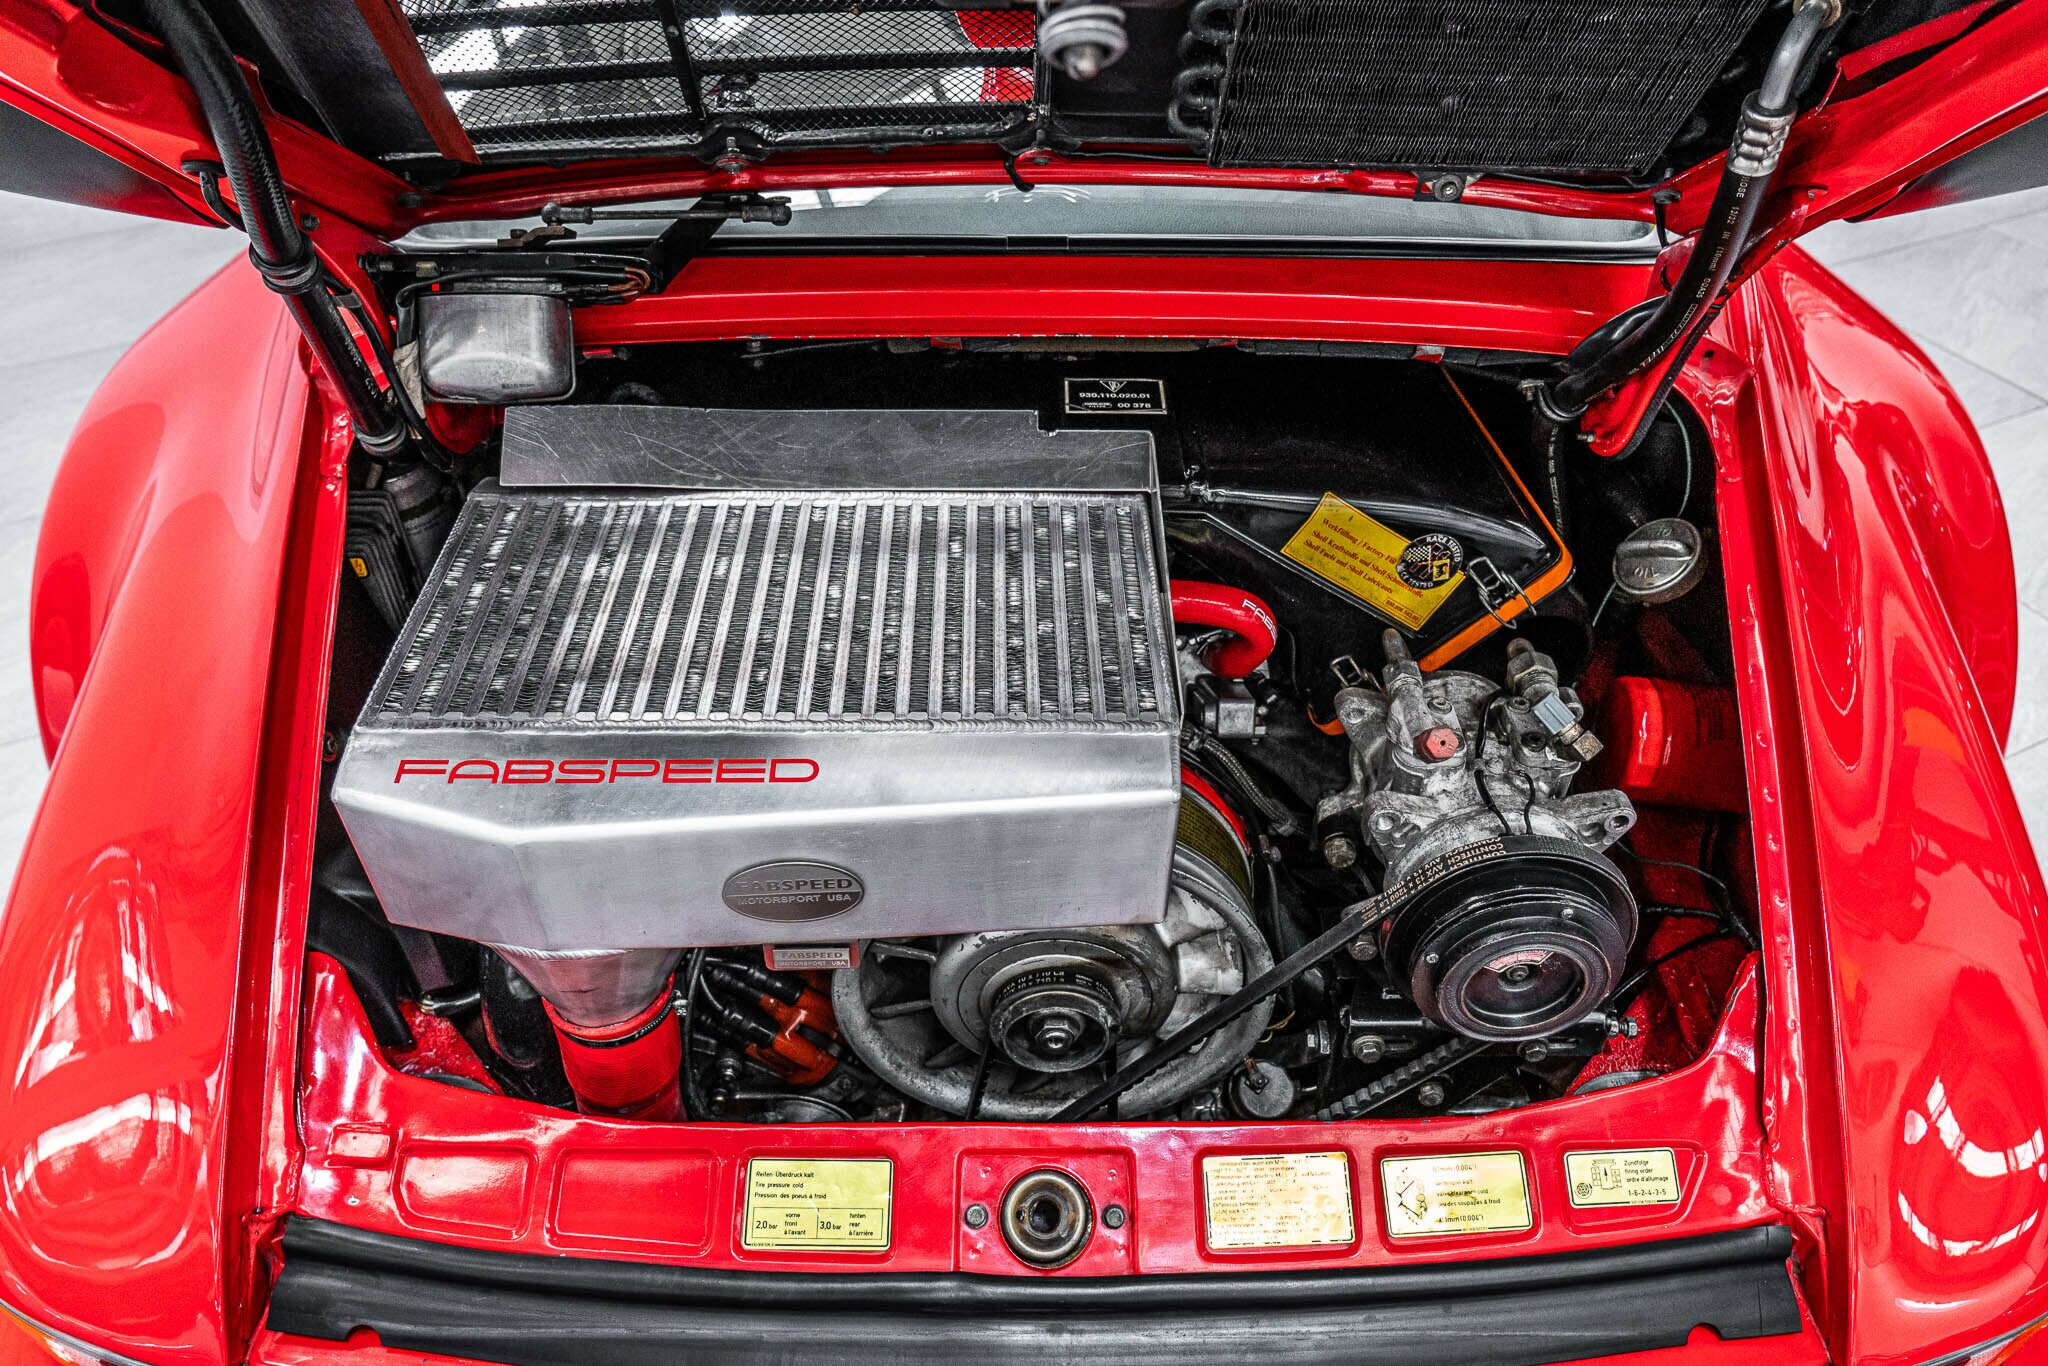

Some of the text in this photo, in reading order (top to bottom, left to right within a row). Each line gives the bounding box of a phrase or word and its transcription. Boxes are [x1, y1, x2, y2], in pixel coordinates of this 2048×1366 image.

[1311, 529, 1328, 543] Shell
[1359, 557, 1371, 567] und
[1370, 562, 1387, 577] Shell
[1361, 541, 1385, 560] Factory
[1426, 534, 1461, 562] RACE TESTED
[1303, 539, 1393, 594] Shell Fuels and Shell Lubricants
[1634, 567, 1660, 578] OIL
[393, 758, 820, 784] FABSPEED
[1447, 843, 1504, 865] CONTITECH
[1426, 862, 1444, 878] AVX
[734, 878, 853, 892] FABSPEED
[1415, 874, 1426, 886] 13
[738, 894, 821, 905] MOTORSPORT
[1389, 887, 1408, 901] 1200
[1628, 1188, 1667, 1197] 1-6-2-4-3-5
[756, 1220, 768, 1230] 2,0
[819, 1221, 832, 1230] 3,0
